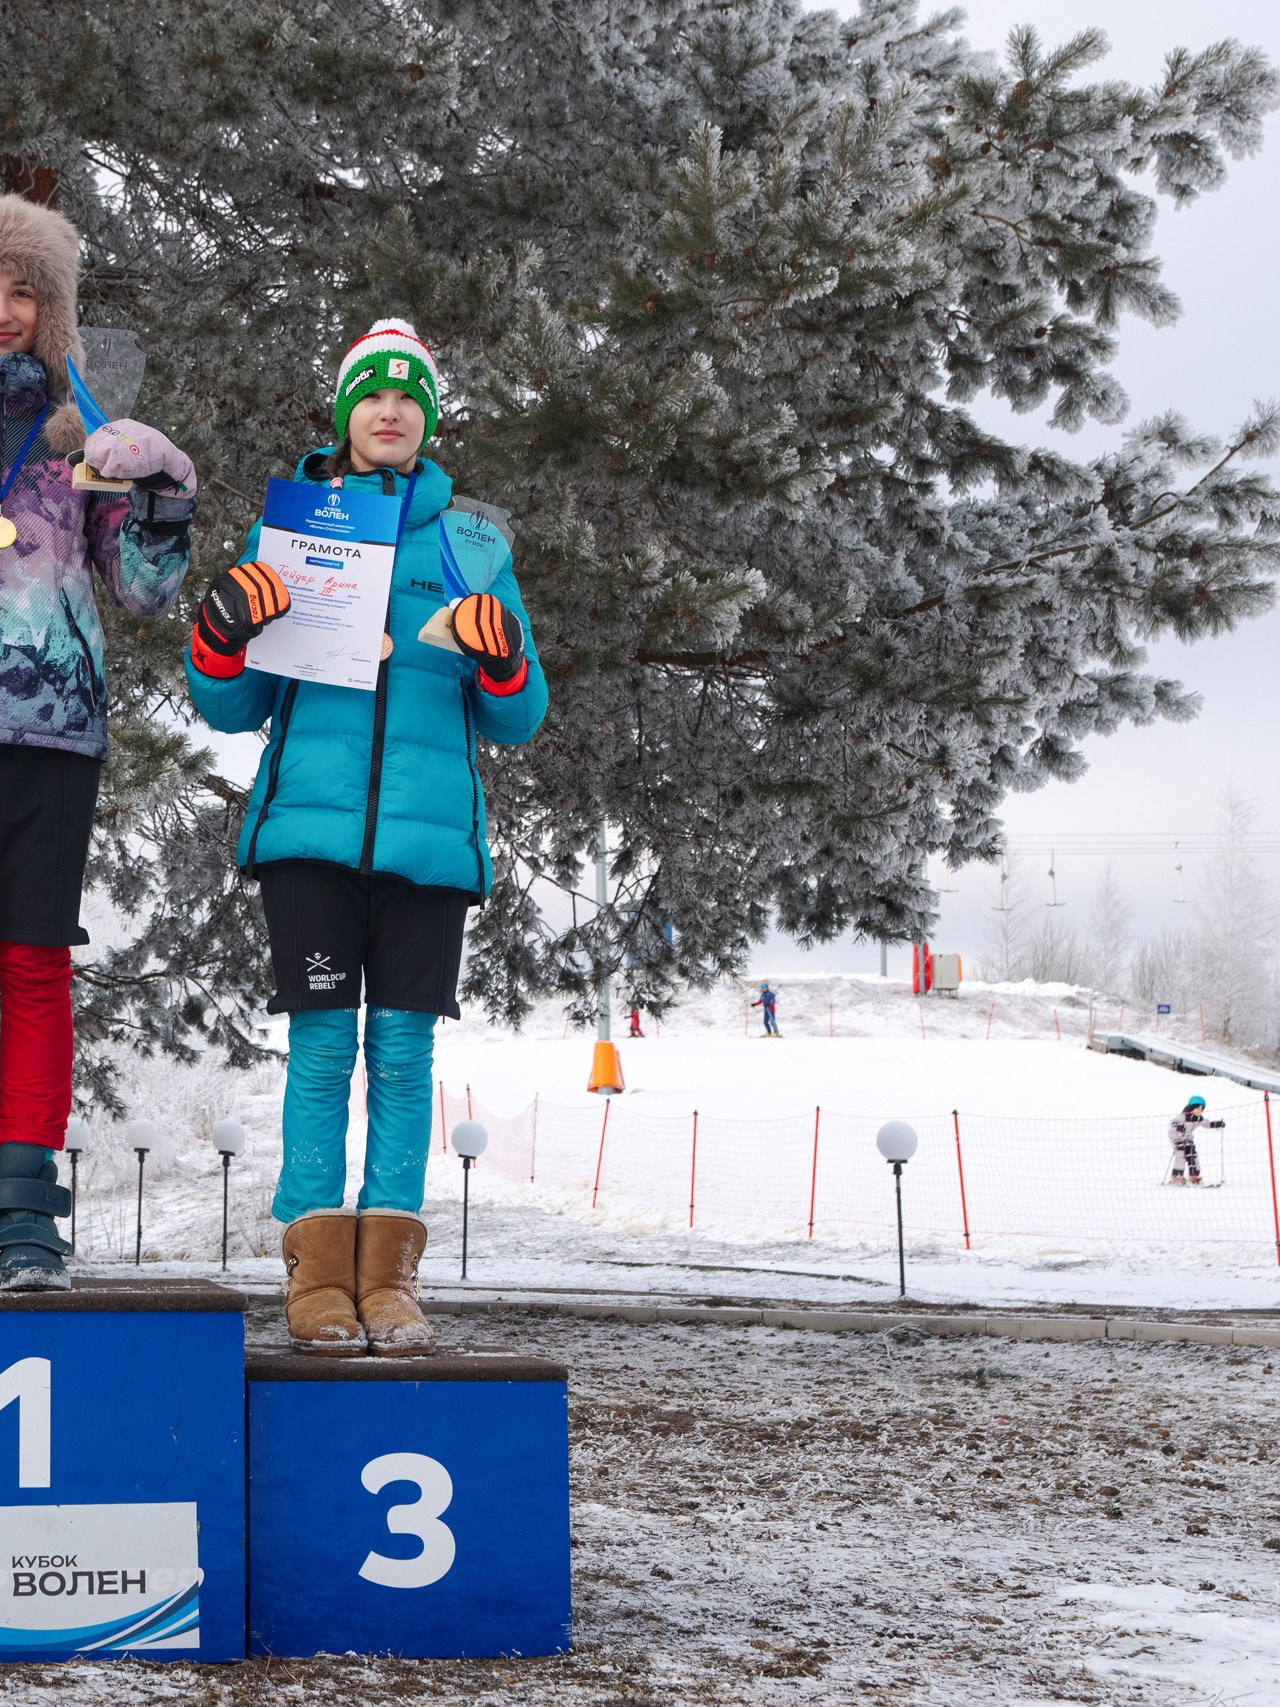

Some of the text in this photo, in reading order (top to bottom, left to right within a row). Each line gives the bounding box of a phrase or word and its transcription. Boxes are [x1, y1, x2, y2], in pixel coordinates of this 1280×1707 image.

[86, 360, 128, 370] ВОЛЕН
[314, 508, 349, 521] ВОЛЕН
[456, 526, 496, 545] ВОЛЕН
[291, 539, 362, 559] ГРАМОТА
[465, 539, 485, 548] КУБОК
[324, 576, 358, 590] Арина
[410, 578, 445, 594] HE
[210, 589, 235, 624] reusch
[250, 594, 258, 619] racing
[308, 972, 347, 983] WORLDCUP
[309, 982, 336, 990] REBELS
[356, 1452, 455, 1588] 3
[12, 1555, 78, 1569] КУБОК
[12, 1570, 147, 1597] ВОЛЕН
